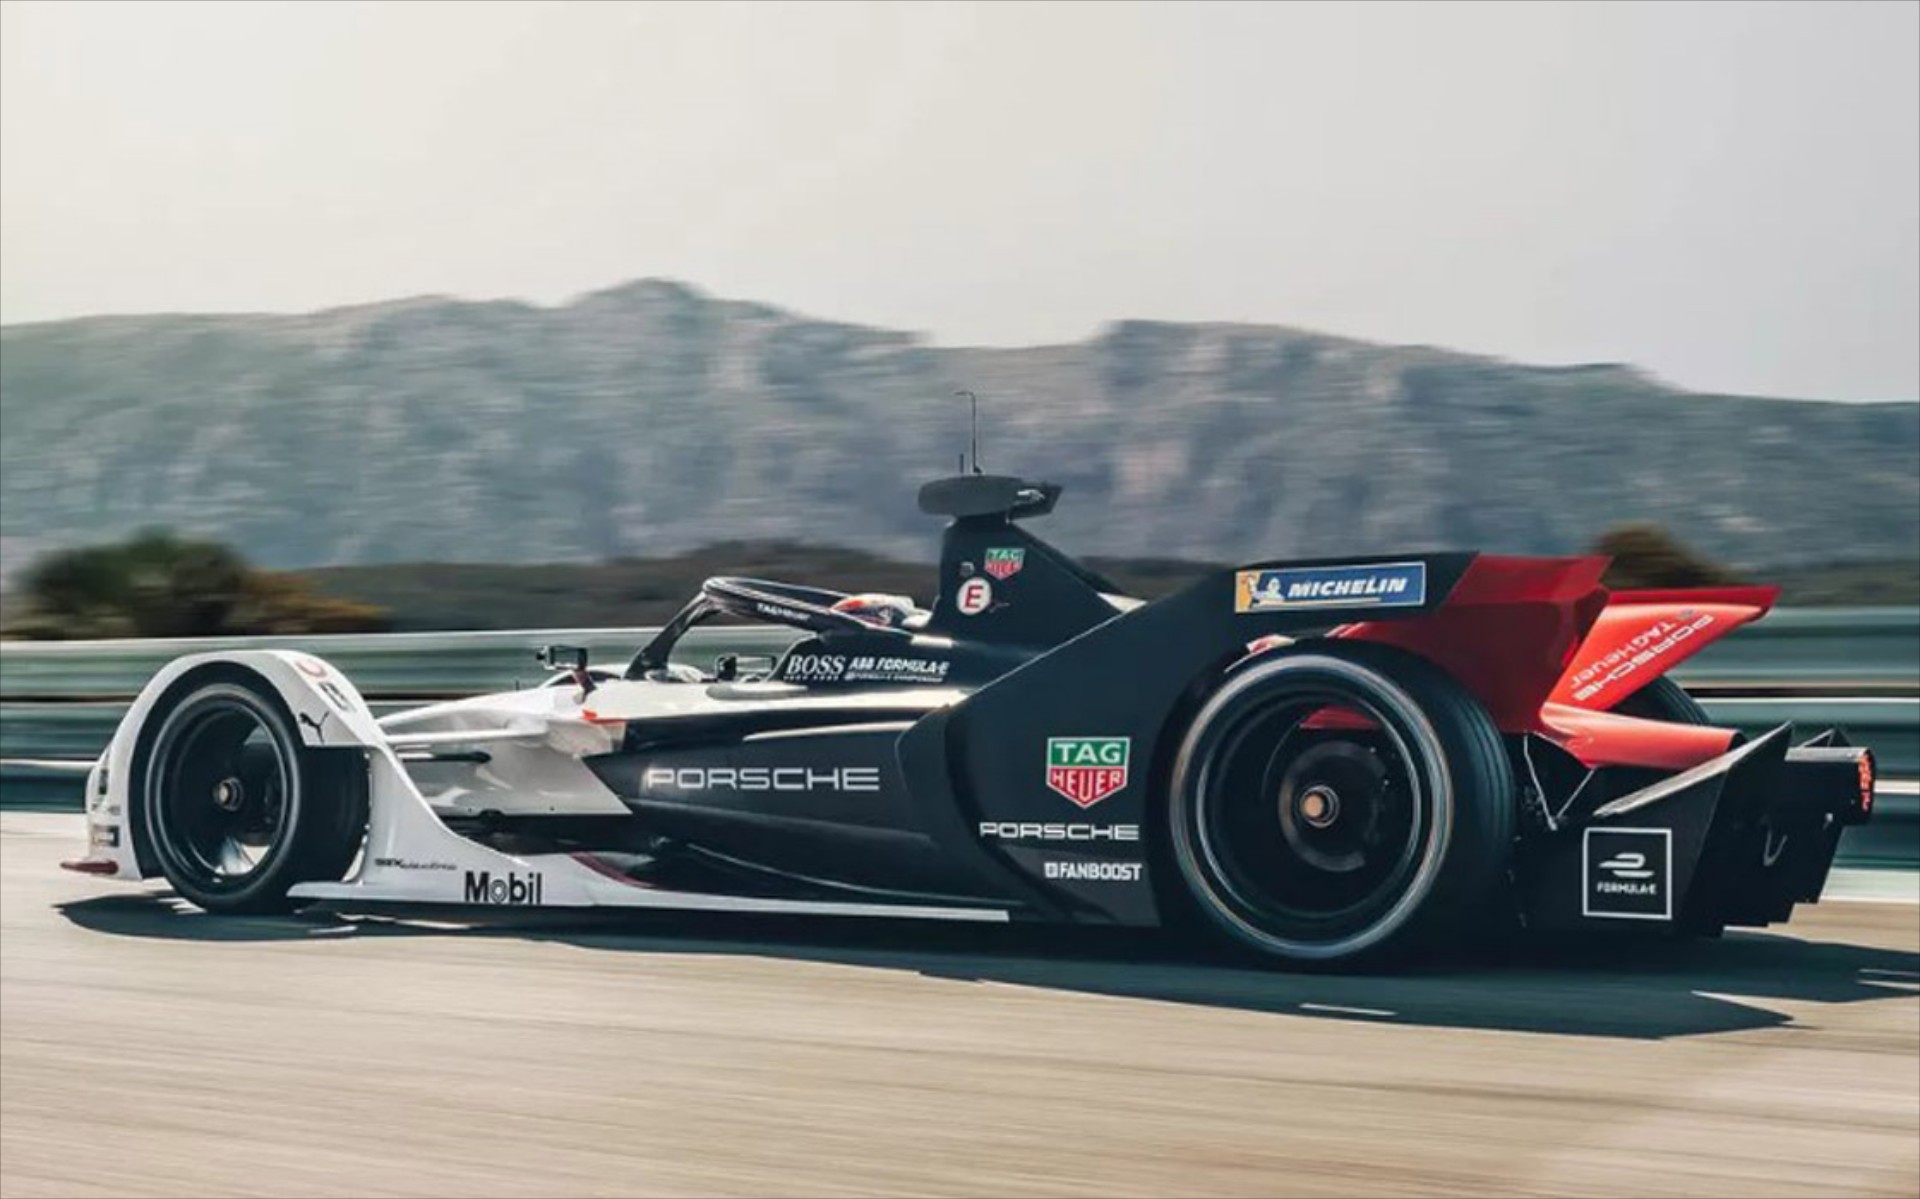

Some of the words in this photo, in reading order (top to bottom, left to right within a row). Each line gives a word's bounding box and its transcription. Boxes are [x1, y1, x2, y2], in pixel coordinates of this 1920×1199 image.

[991, 549, 1019, 560] TAG
[965, 585, 984, 608] E
[1286, 578, 1408, 598] MICHELIN
[786, 655, 846, 675] BOSS
[848, 657, 875, 671] ABB
[1572, 615, 1714, 701] PORSCHE
[1055, 742, 1122, 764] TAG
[648, 767, 879, 791] PORSCHE
[1051, 770, 1123, 800] HEUER
[980, 821, 1140, 841] PORSCHE
[1060, 862, 1142, 881] FANBOOST
[465, 871, 542, 904] Mobil
